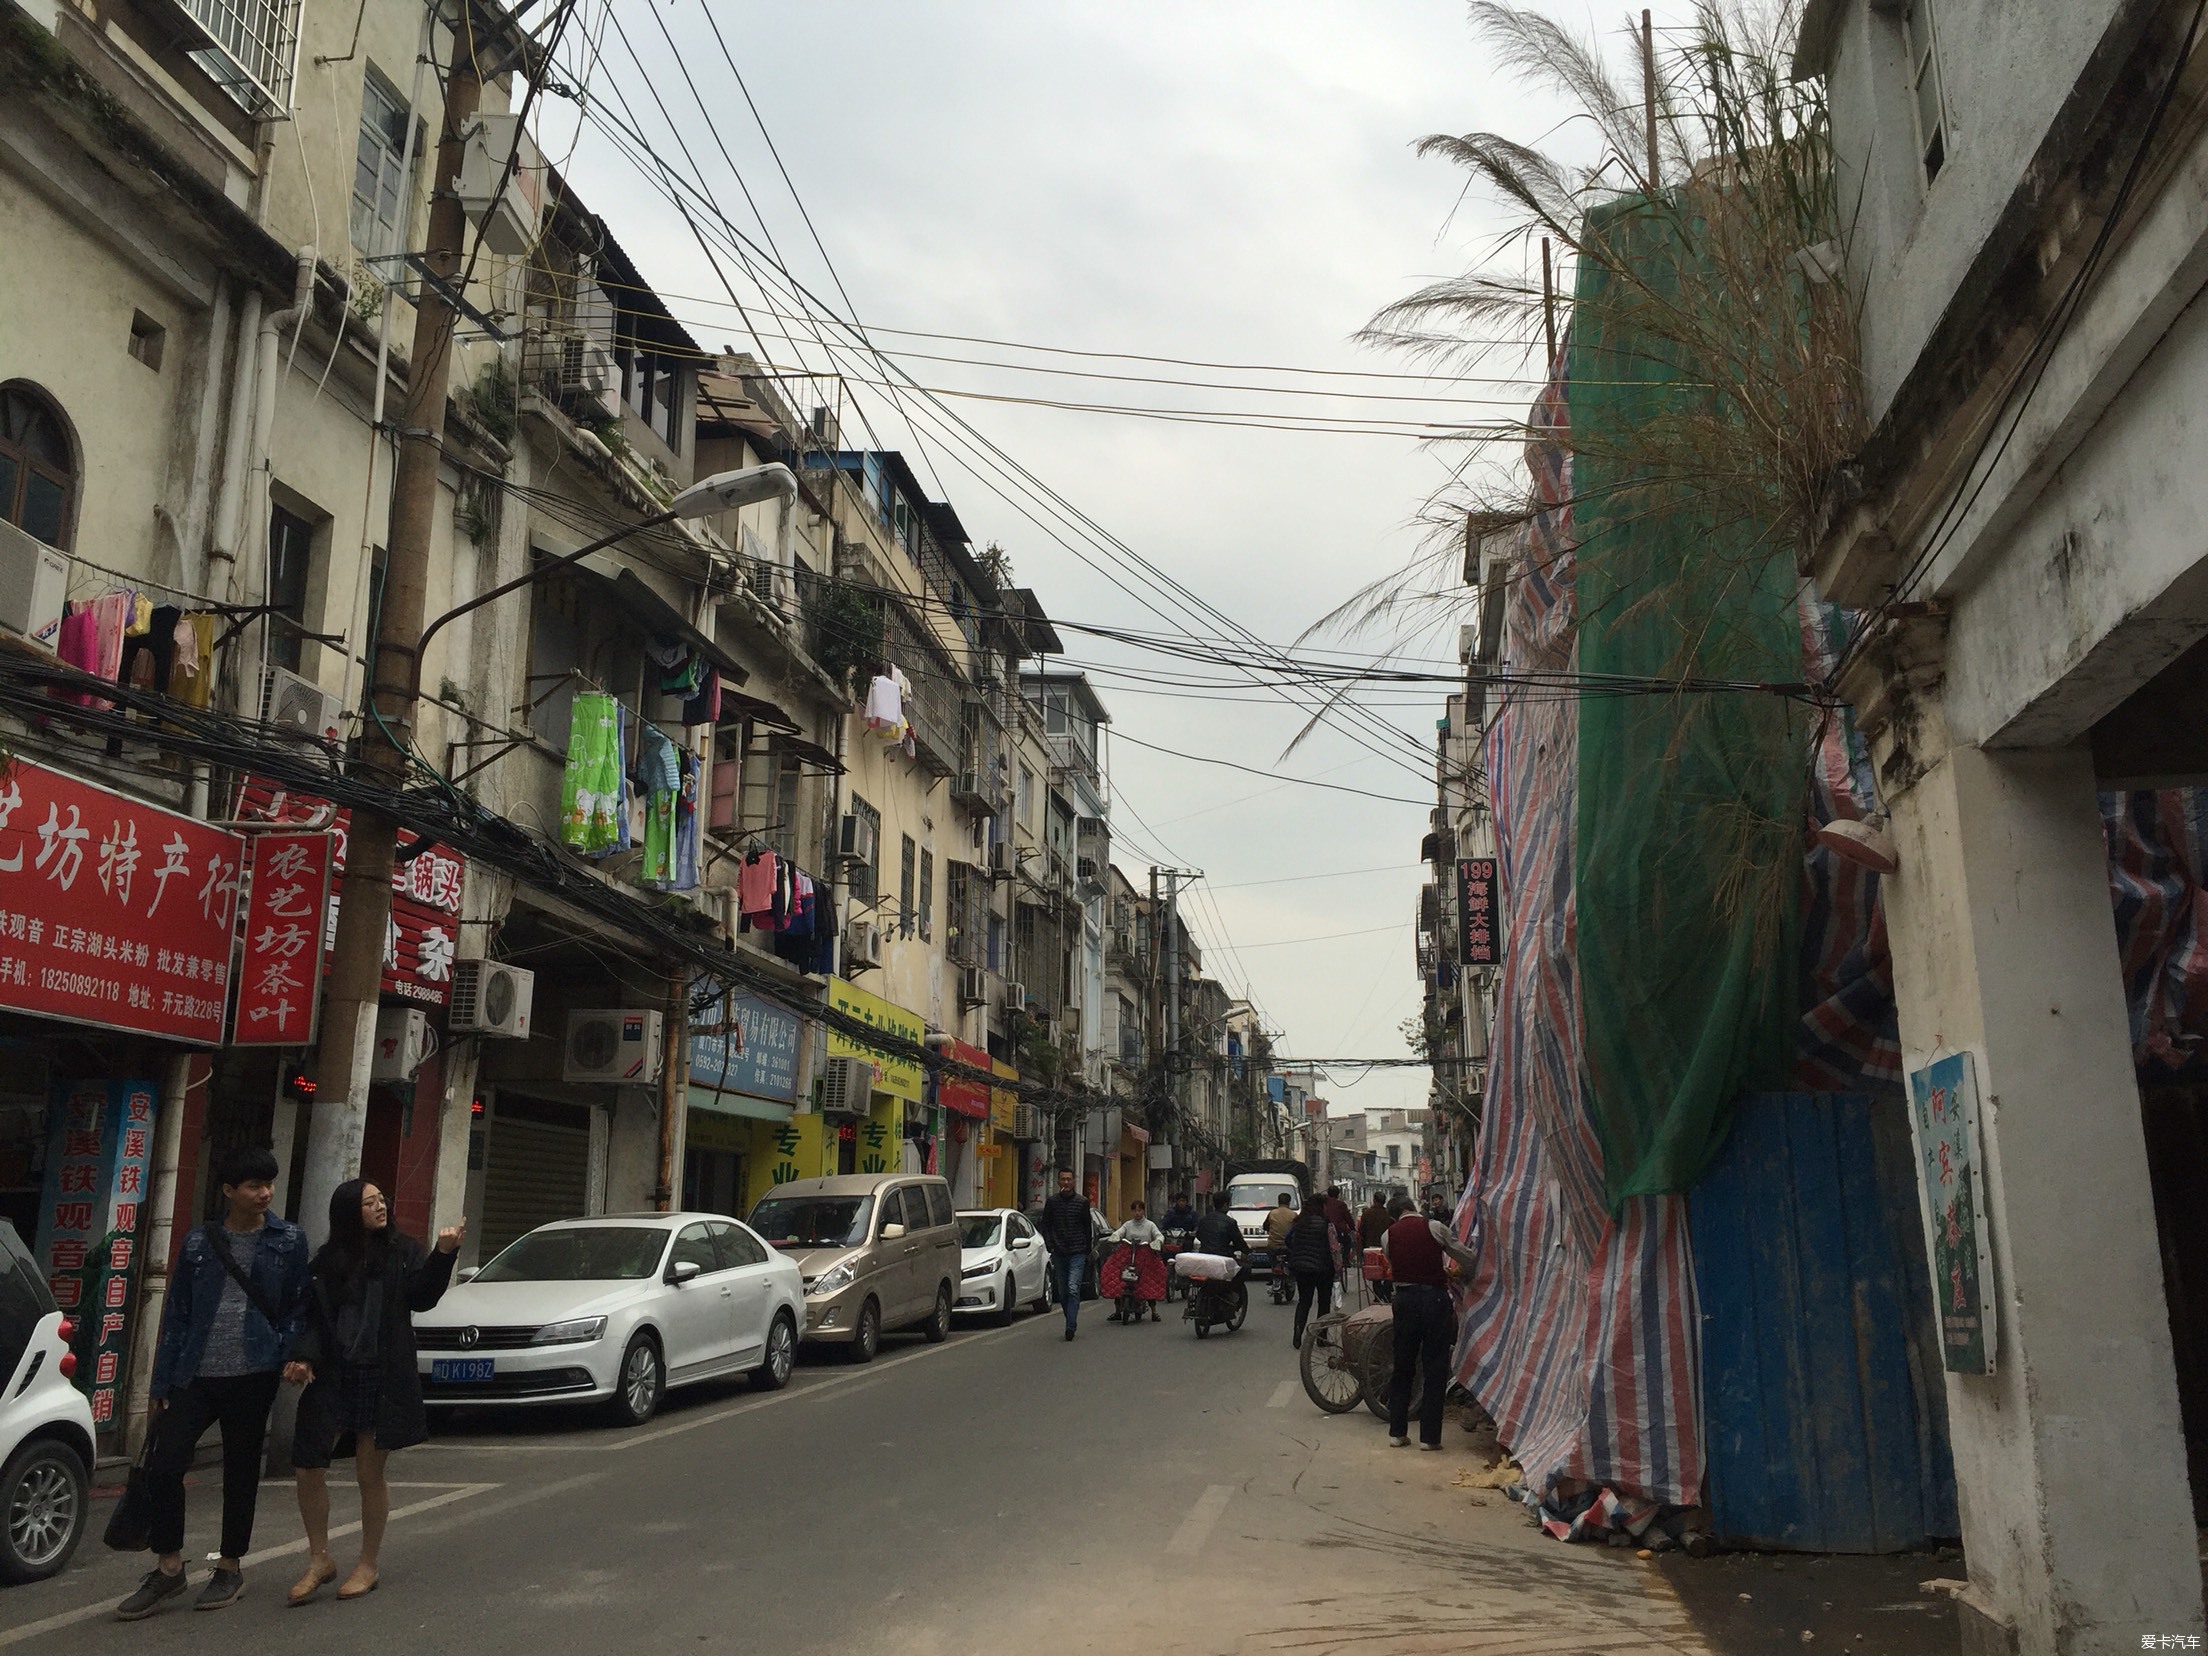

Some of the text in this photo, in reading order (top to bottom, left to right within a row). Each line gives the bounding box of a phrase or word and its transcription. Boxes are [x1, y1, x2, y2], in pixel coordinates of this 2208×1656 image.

[52, 924, 150, 968] 正宗湖头米粉
[157, 947, 227, 986] 批发兼零售
[249, 843, 317, 1032] 农艺坊茶叶
[1460, 861, 1493, 961] 199 海鲜大排档
[772, 1124, 801, 1185] 专业
[91, 1091, 152, 1424] 安溪铁观音自产自销
